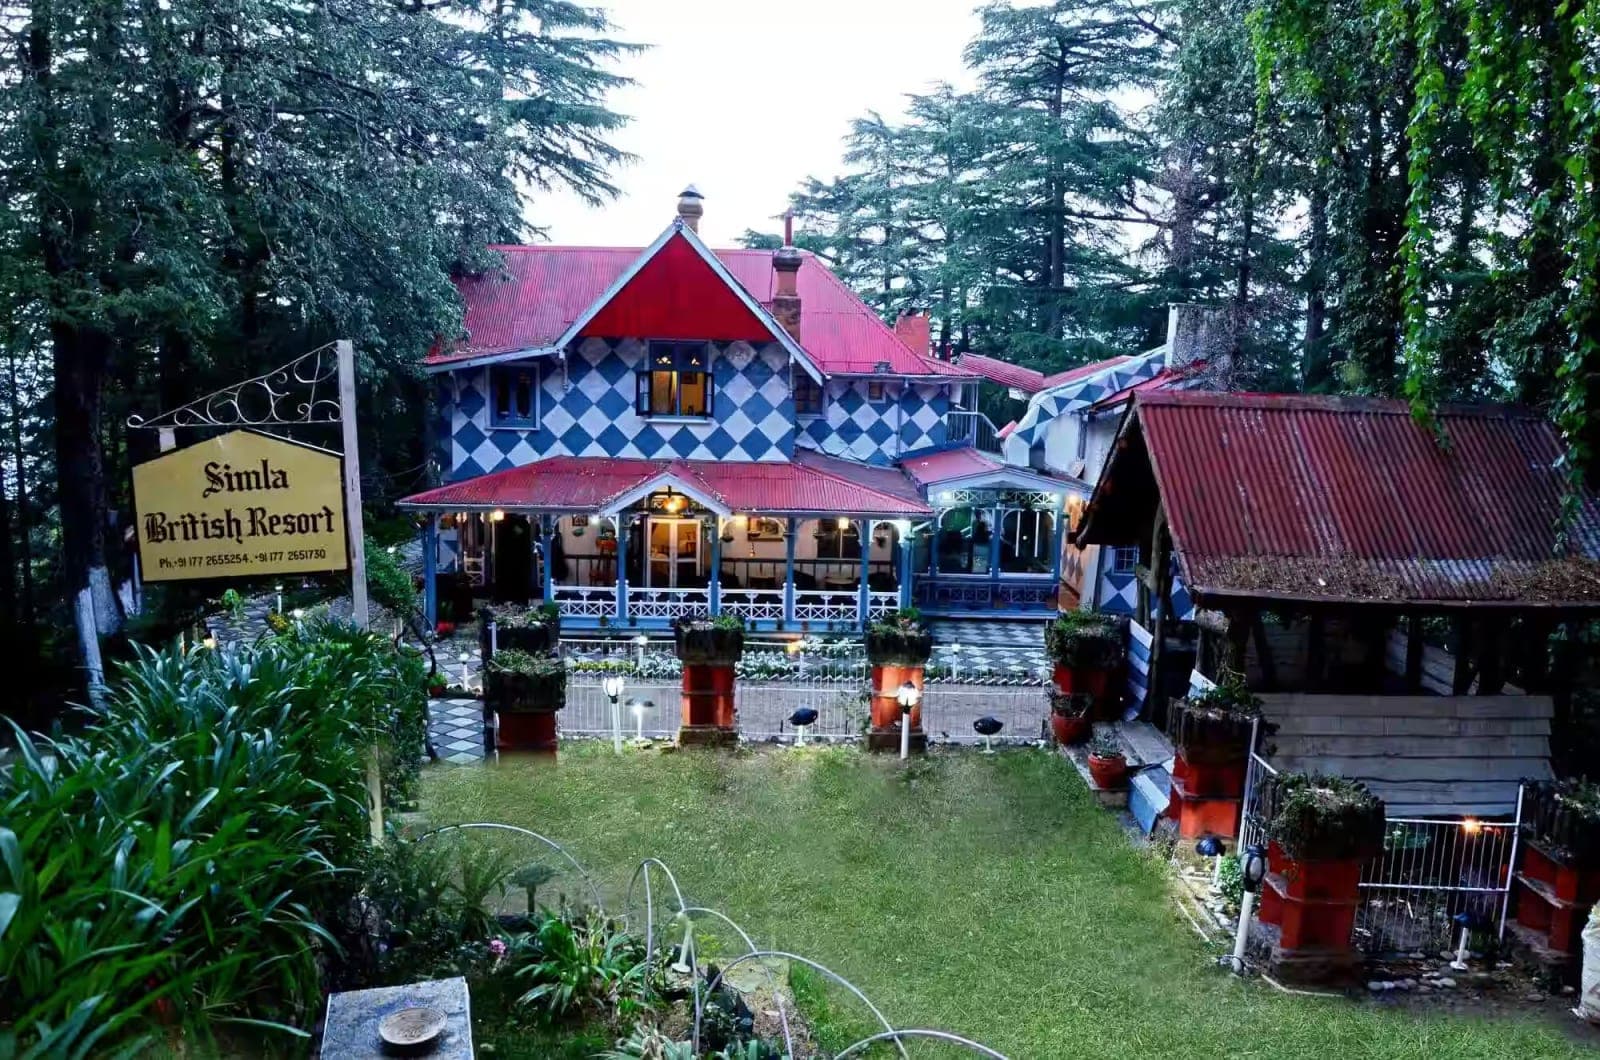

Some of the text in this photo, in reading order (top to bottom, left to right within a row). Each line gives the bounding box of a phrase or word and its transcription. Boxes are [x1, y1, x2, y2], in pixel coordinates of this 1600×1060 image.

[203, 459, 289, 498] Simla
[144, 506, 335, 544] British Resort
[287, 549, 327, 561] 2651730
